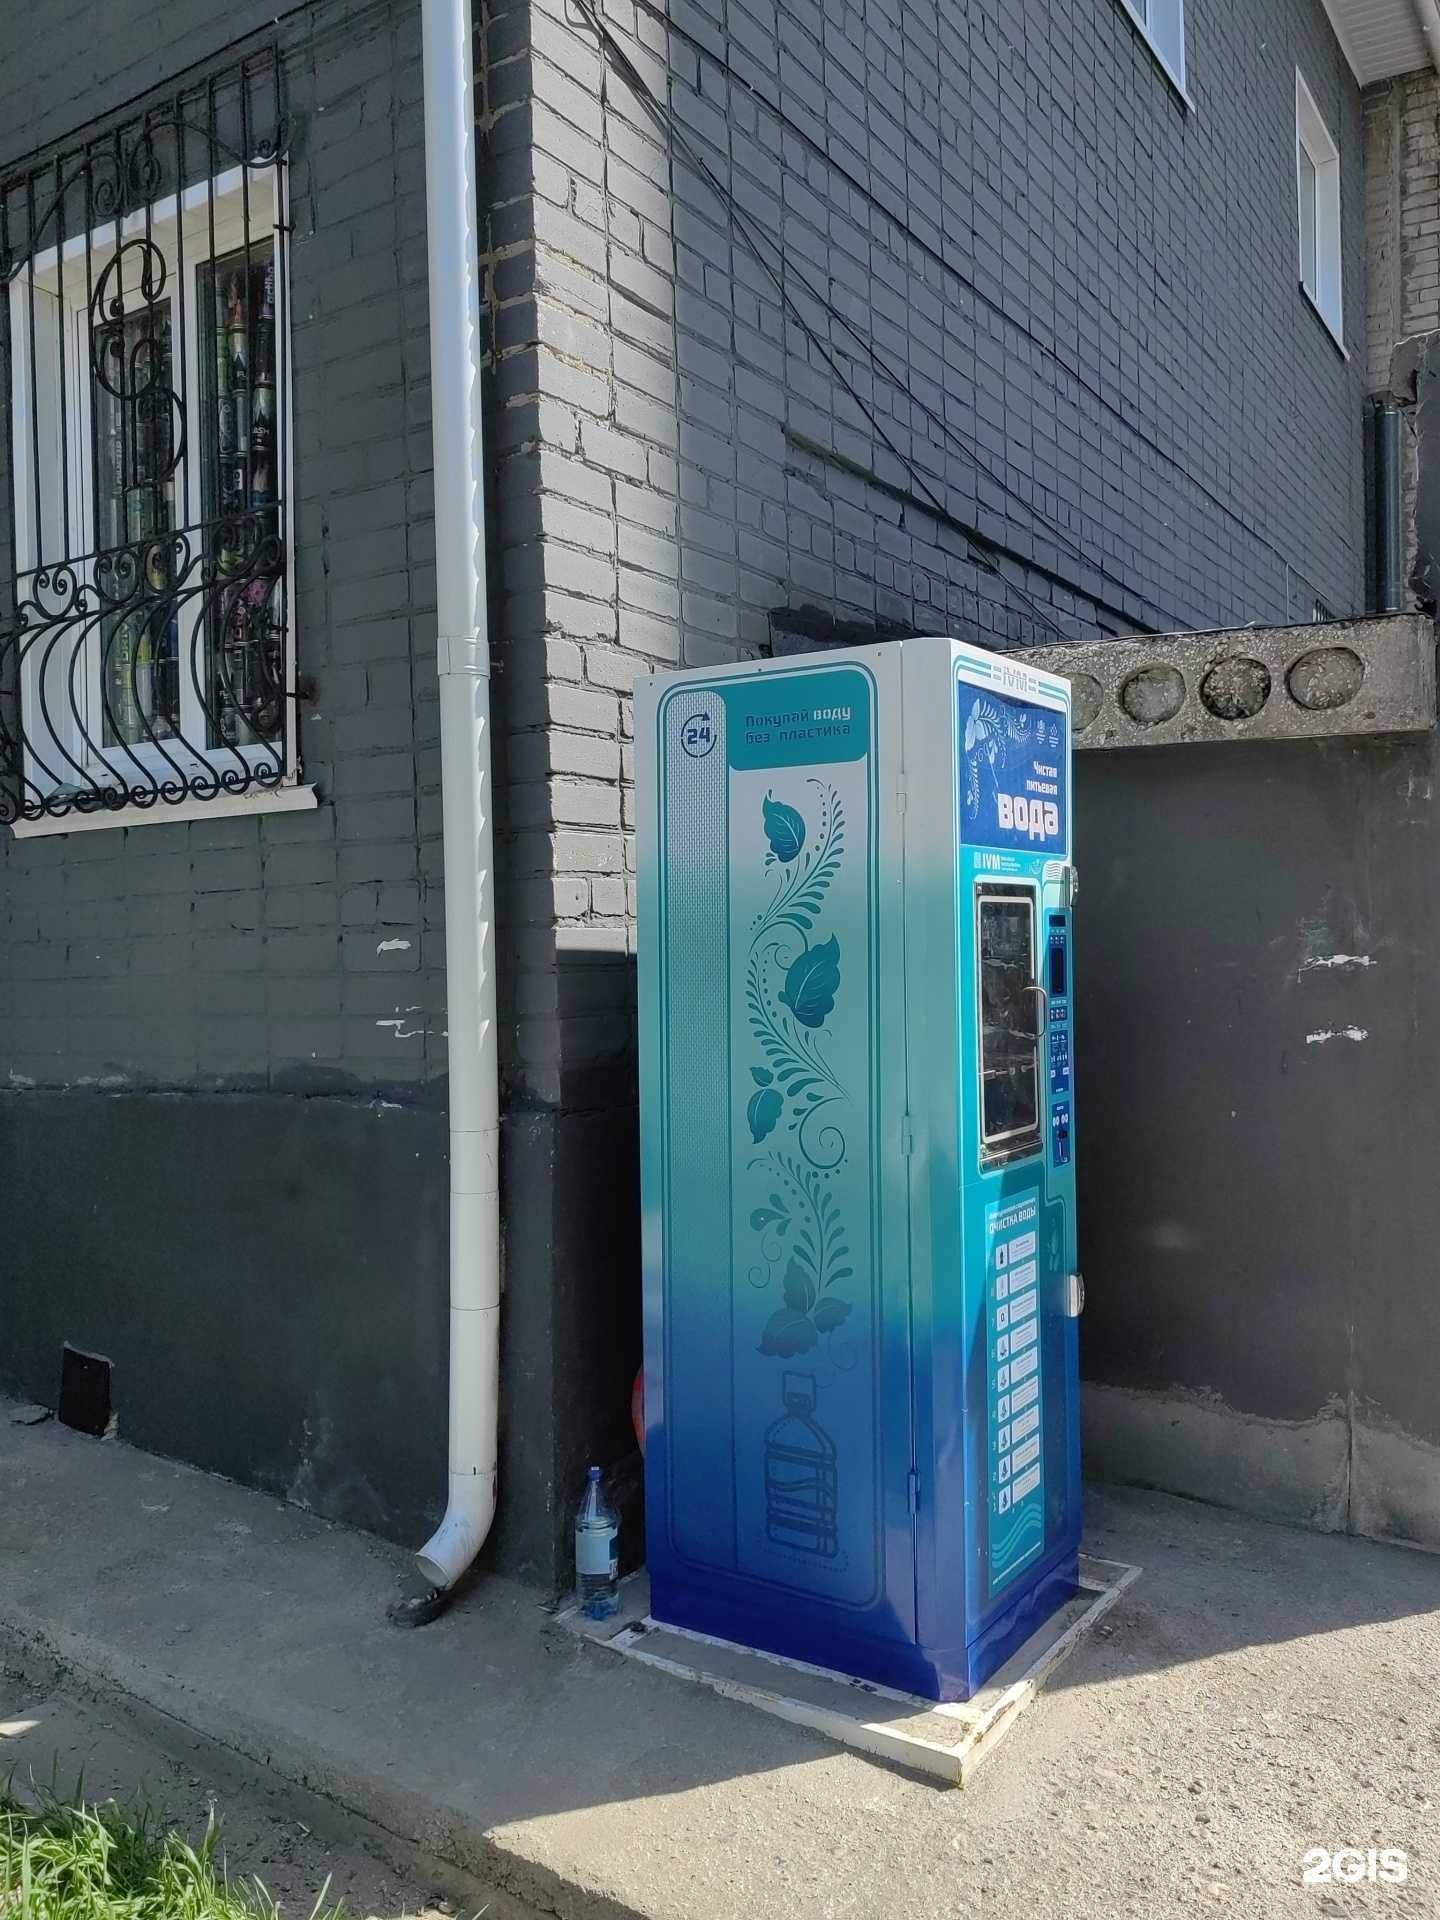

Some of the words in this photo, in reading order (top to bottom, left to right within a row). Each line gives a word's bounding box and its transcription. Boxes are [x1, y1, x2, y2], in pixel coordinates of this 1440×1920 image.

[745, 710, 809, 728] Покупай
[813, 706, 851, 721] воду
[687, 726, 711, 745] 24
[745, 731, 770, 745] без
[779, 724, 850, 741] пластика
[1033, 761, 1057, 778] Чистая
[1026, 779, 1058, 795] питьевая
[982, 853, 1001, 871] IVM
[989, 1213, 1018, 1234] ОЧИСТКА
[1018, 1205, 1036, 1222] ВОДЫ
